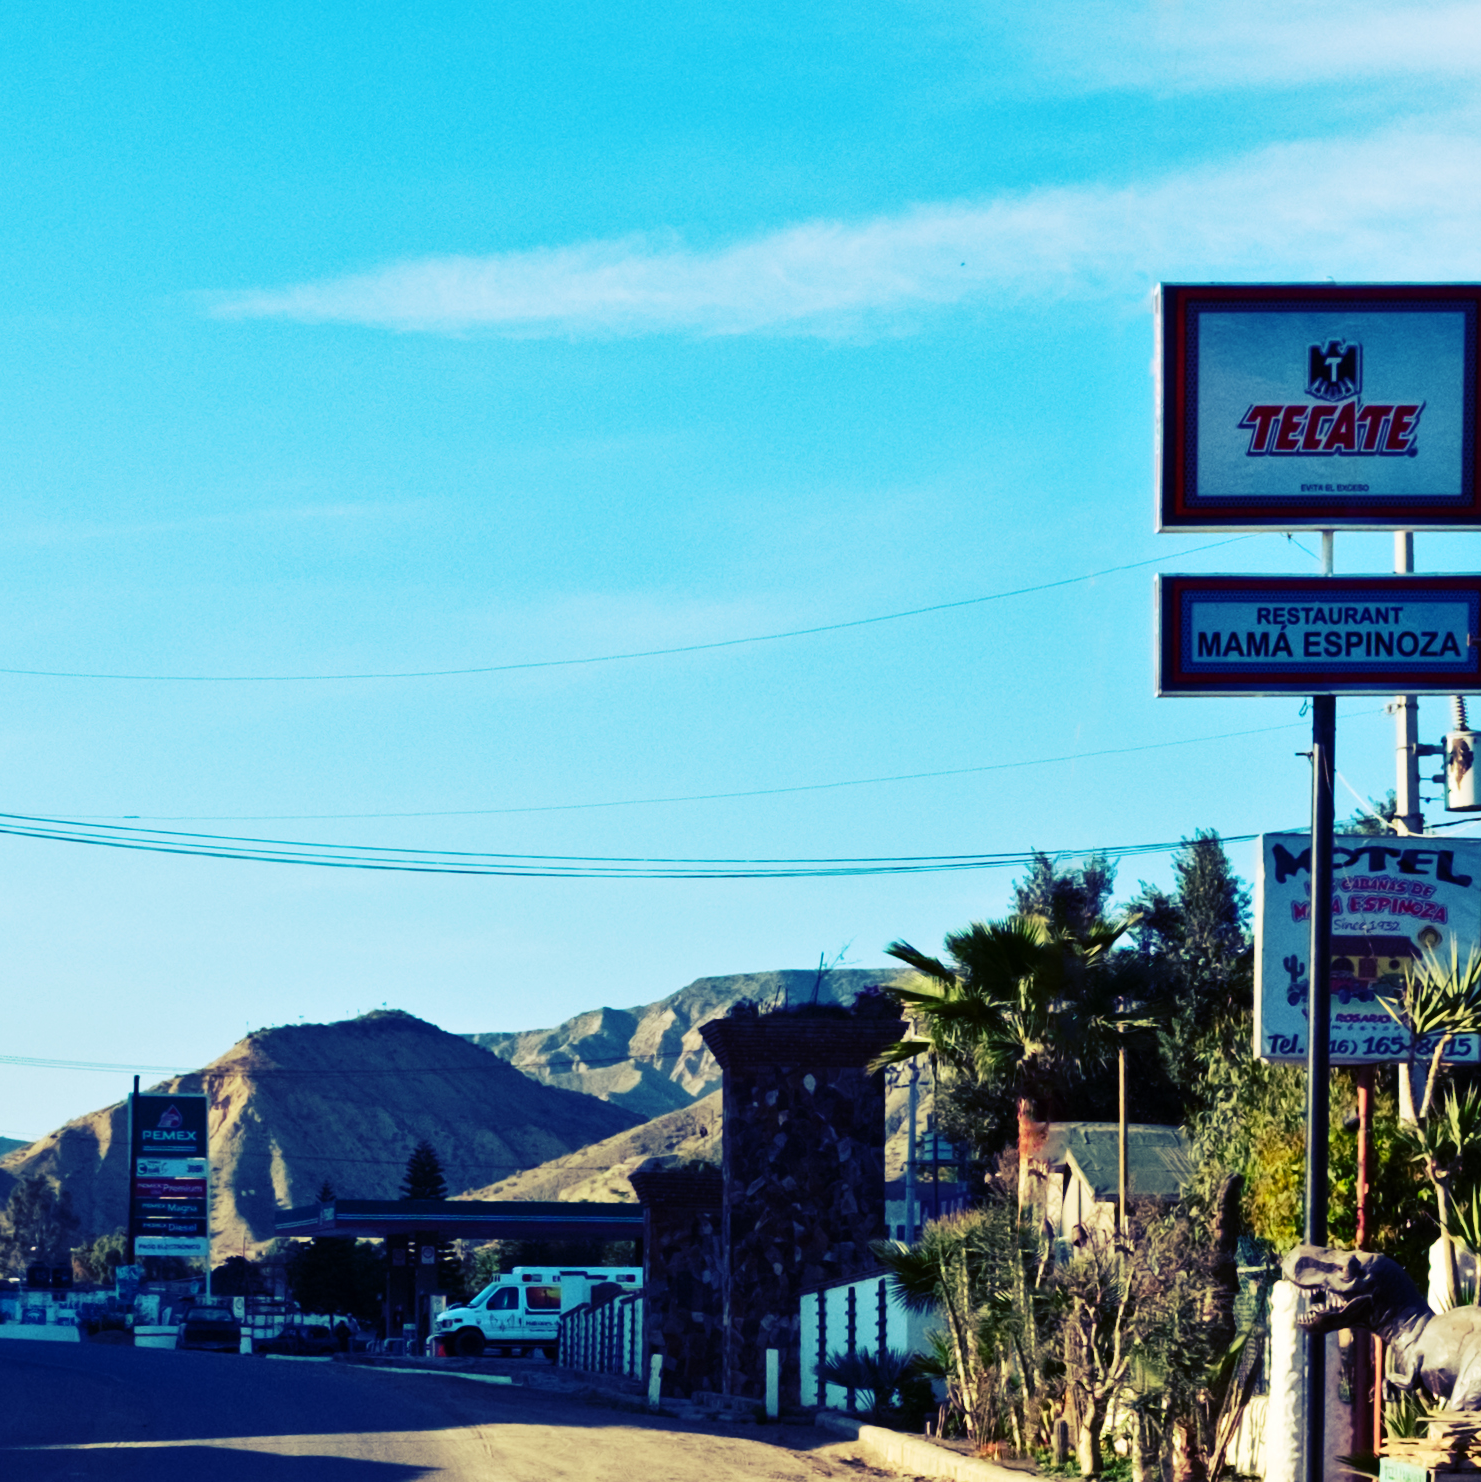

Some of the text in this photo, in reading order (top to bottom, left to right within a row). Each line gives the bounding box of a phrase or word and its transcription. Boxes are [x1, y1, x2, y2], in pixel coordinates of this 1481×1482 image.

[1238, 401, 1424, 457] TECATE
[1257, 607, 1403, 625] RESTAURANT
[1197, 625, 1461, 658] MAMÁ ESPINOZA
[1348, 896, 1448, 923] ESPINOZA
[1268, 1033, 1305, 1055] Tel.
[142, 1130, 197, 1141] PEMEX
